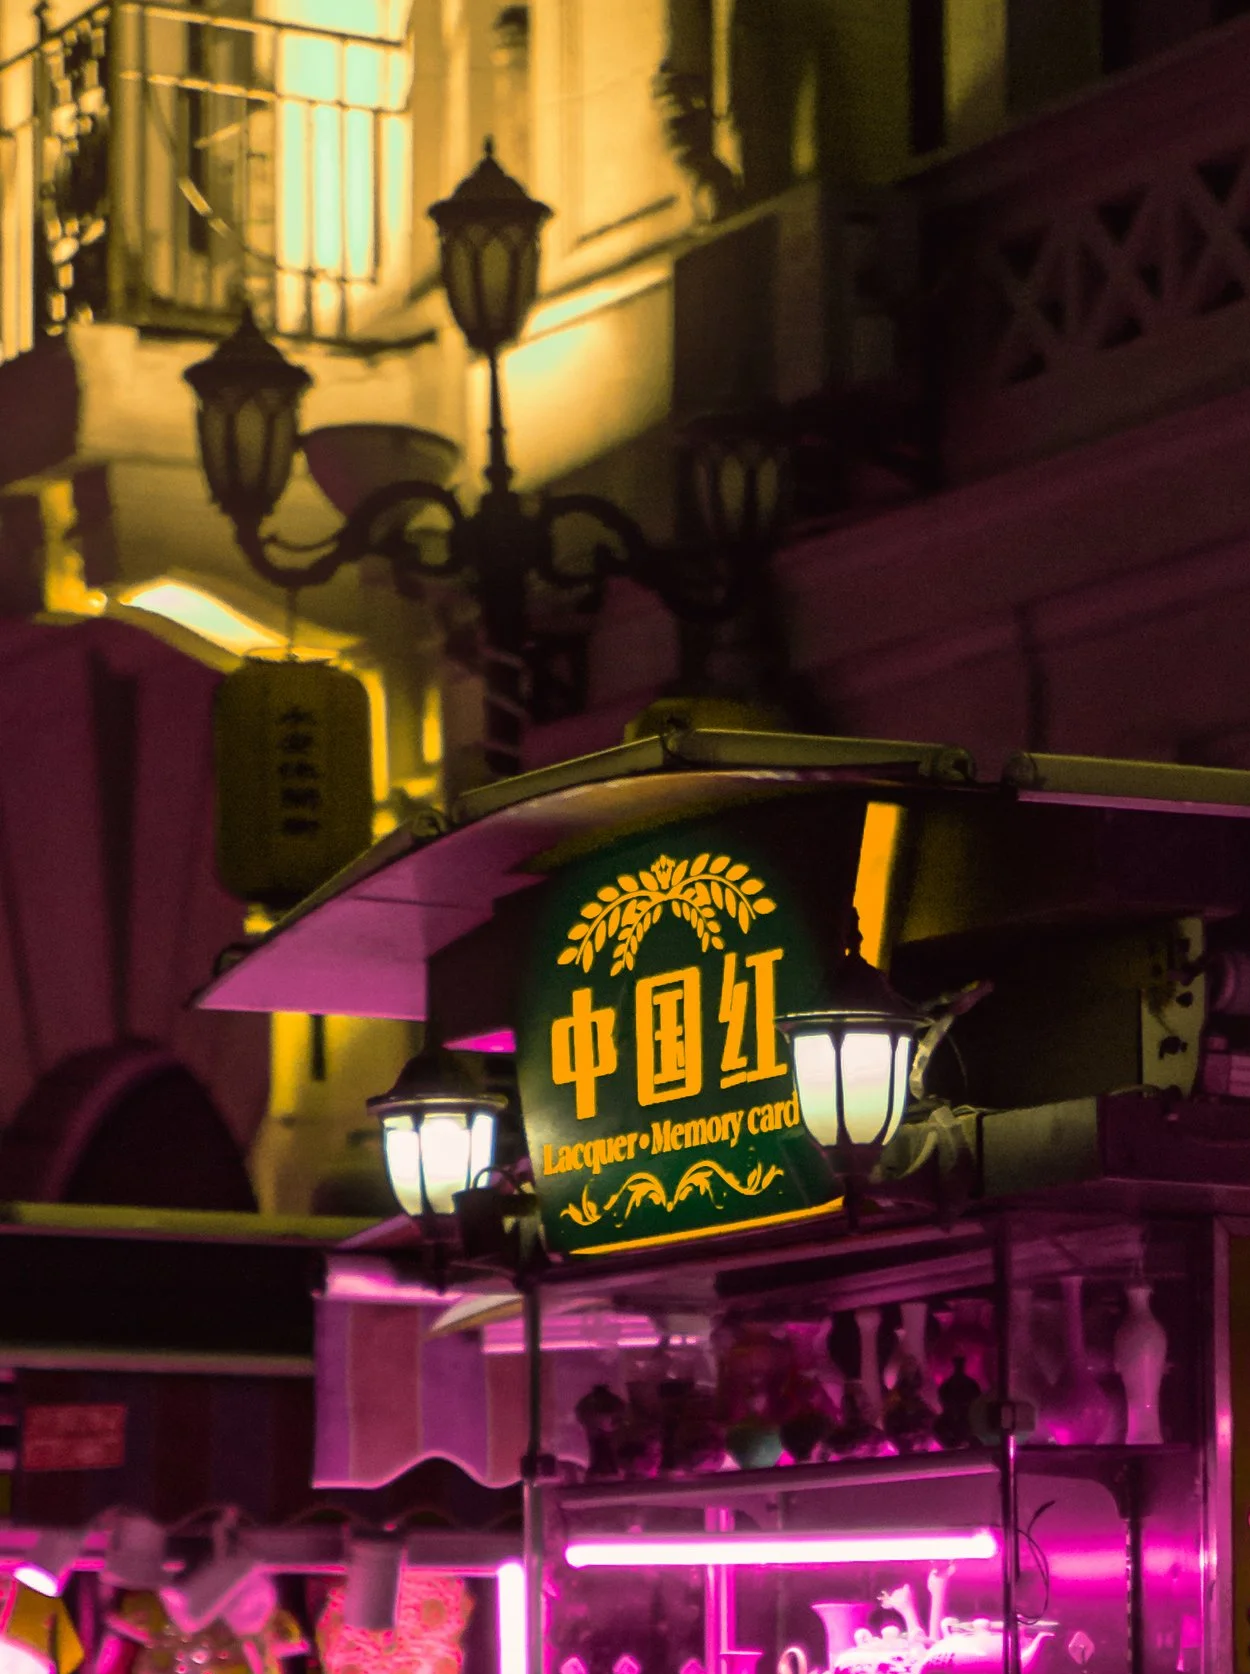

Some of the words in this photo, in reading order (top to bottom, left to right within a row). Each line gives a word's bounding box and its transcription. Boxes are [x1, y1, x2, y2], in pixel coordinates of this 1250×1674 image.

[551, 948, 789, 1121] 中国红
[747, 1092, 800, 1135] card
